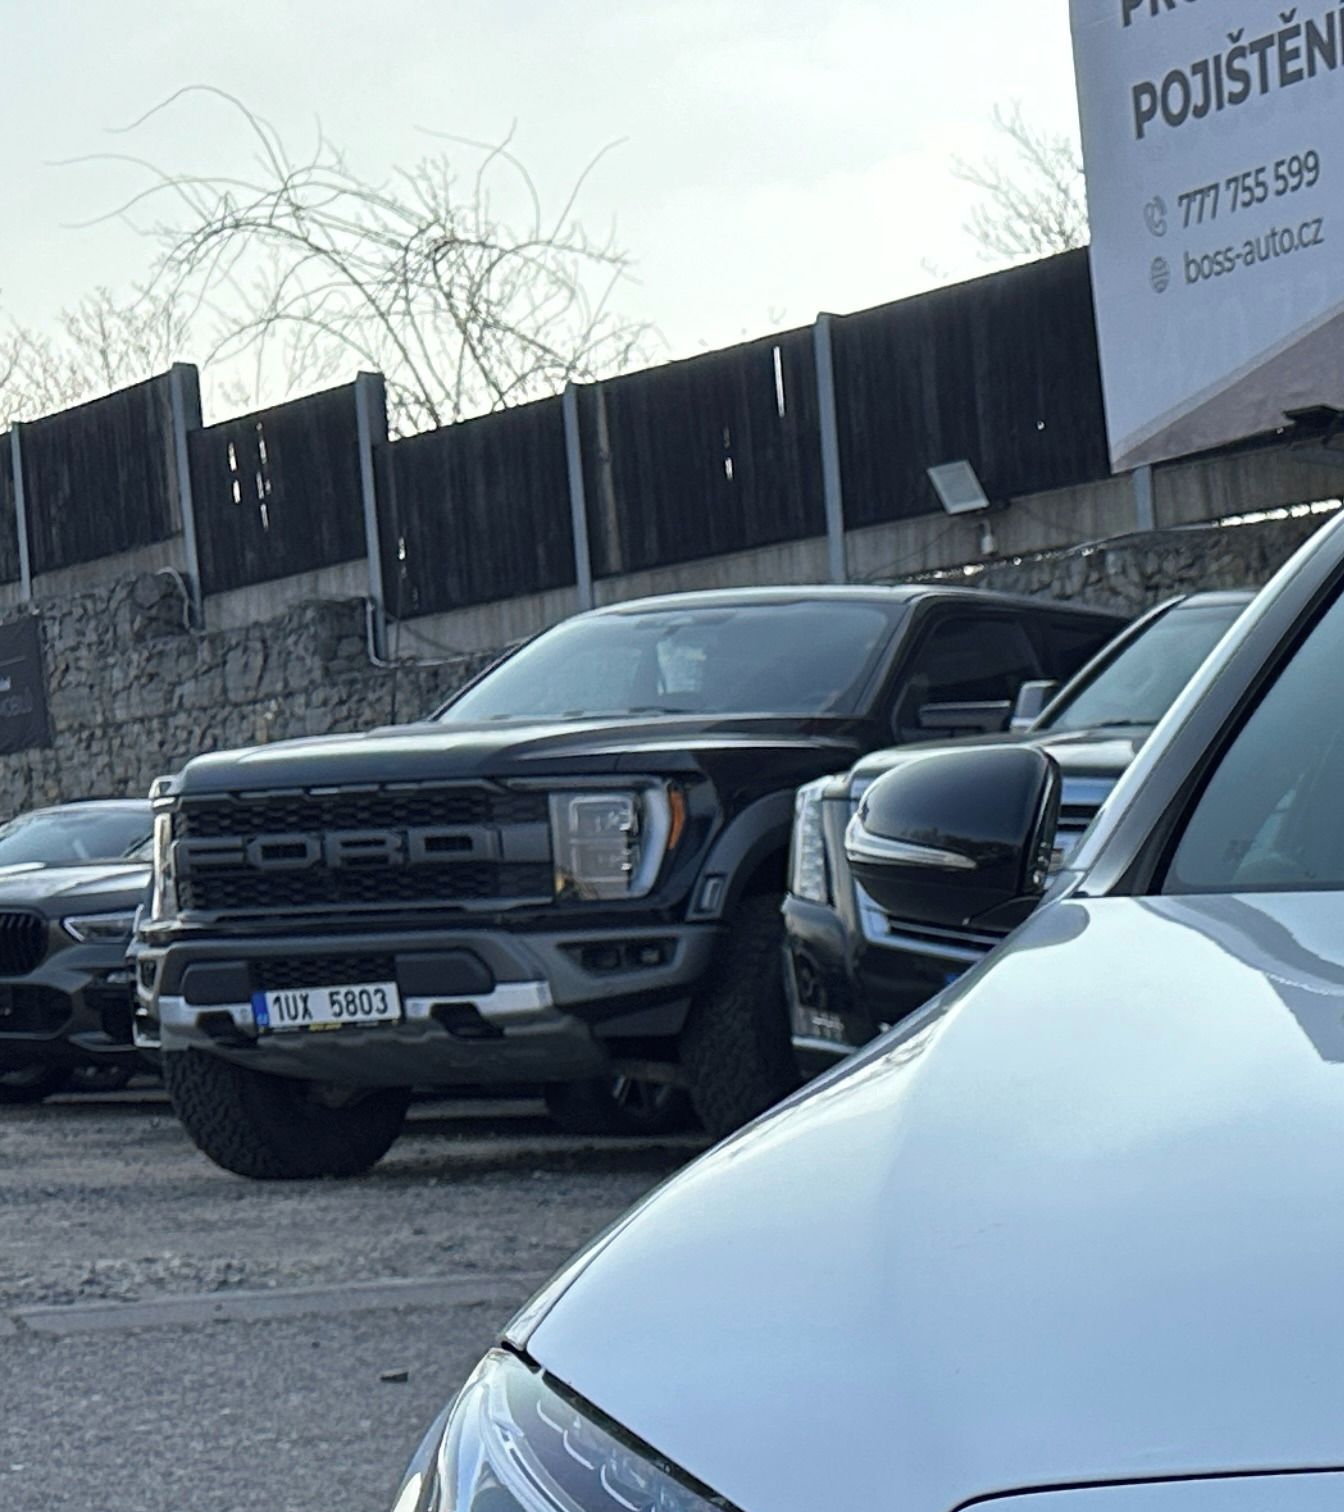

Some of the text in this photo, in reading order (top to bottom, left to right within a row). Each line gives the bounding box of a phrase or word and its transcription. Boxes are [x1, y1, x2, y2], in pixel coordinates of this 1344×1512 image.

[1177, 149, 1320, 229] 777 755 599
[1183, 217, 1325, 285] boss-auto.cz
[172, 824, 500, 877] FORD
[273, 993, 313, 1022] 1UX
[328, 988, 389, 1018] 5803
